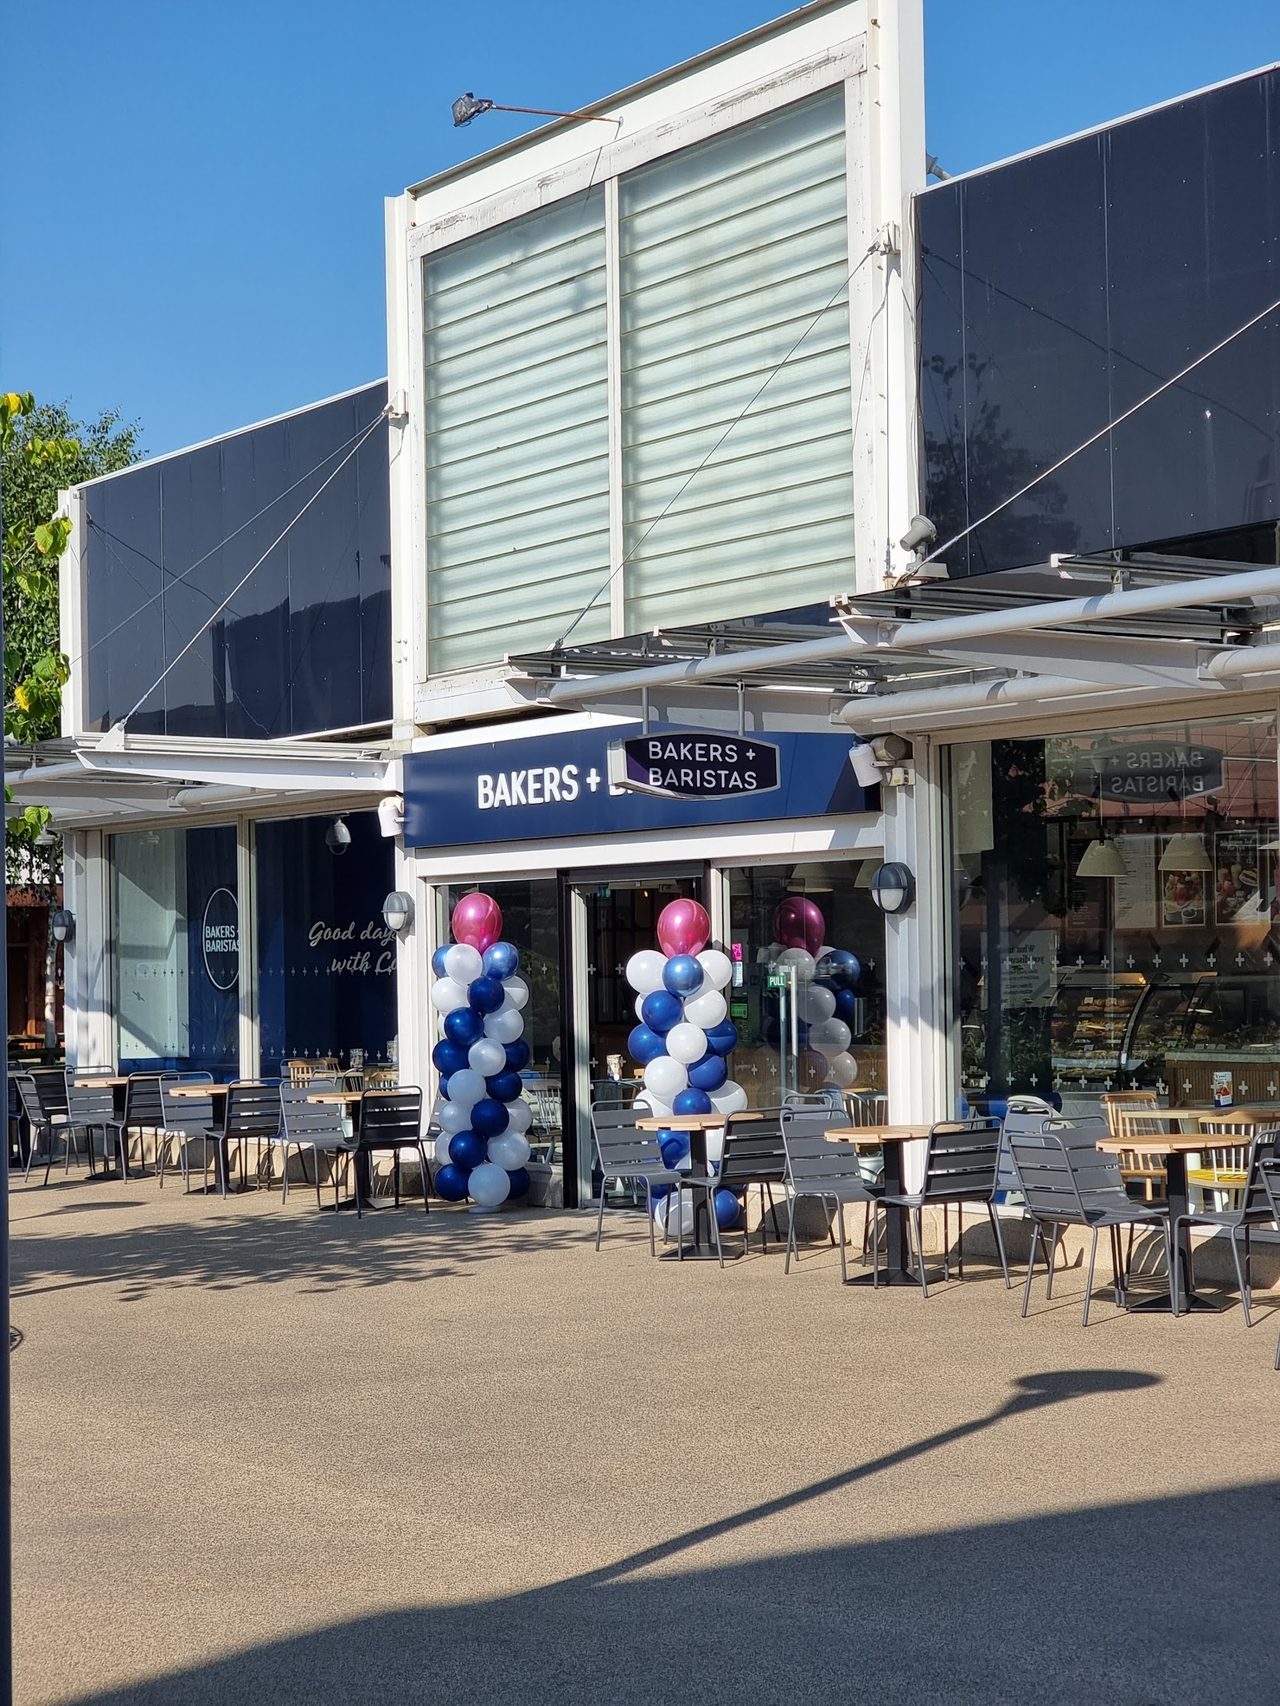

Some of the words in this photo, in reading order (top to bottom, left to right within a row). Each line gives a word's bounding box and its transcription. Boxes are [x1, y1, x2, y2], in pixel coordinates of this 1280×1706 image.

[649, 741, 737, 763] BAKERS
[477, 764, 579, 810] BAKERS
[649, 767, 757, 790] BARISTAS
[205, 925, 236, 939] BAKERS
[308, 920, 356, 947] Good
[205, 939, 240, 953] BARISTAS
[331, 951, 372, 972] with
[769, 975, 785, 986] PULL
